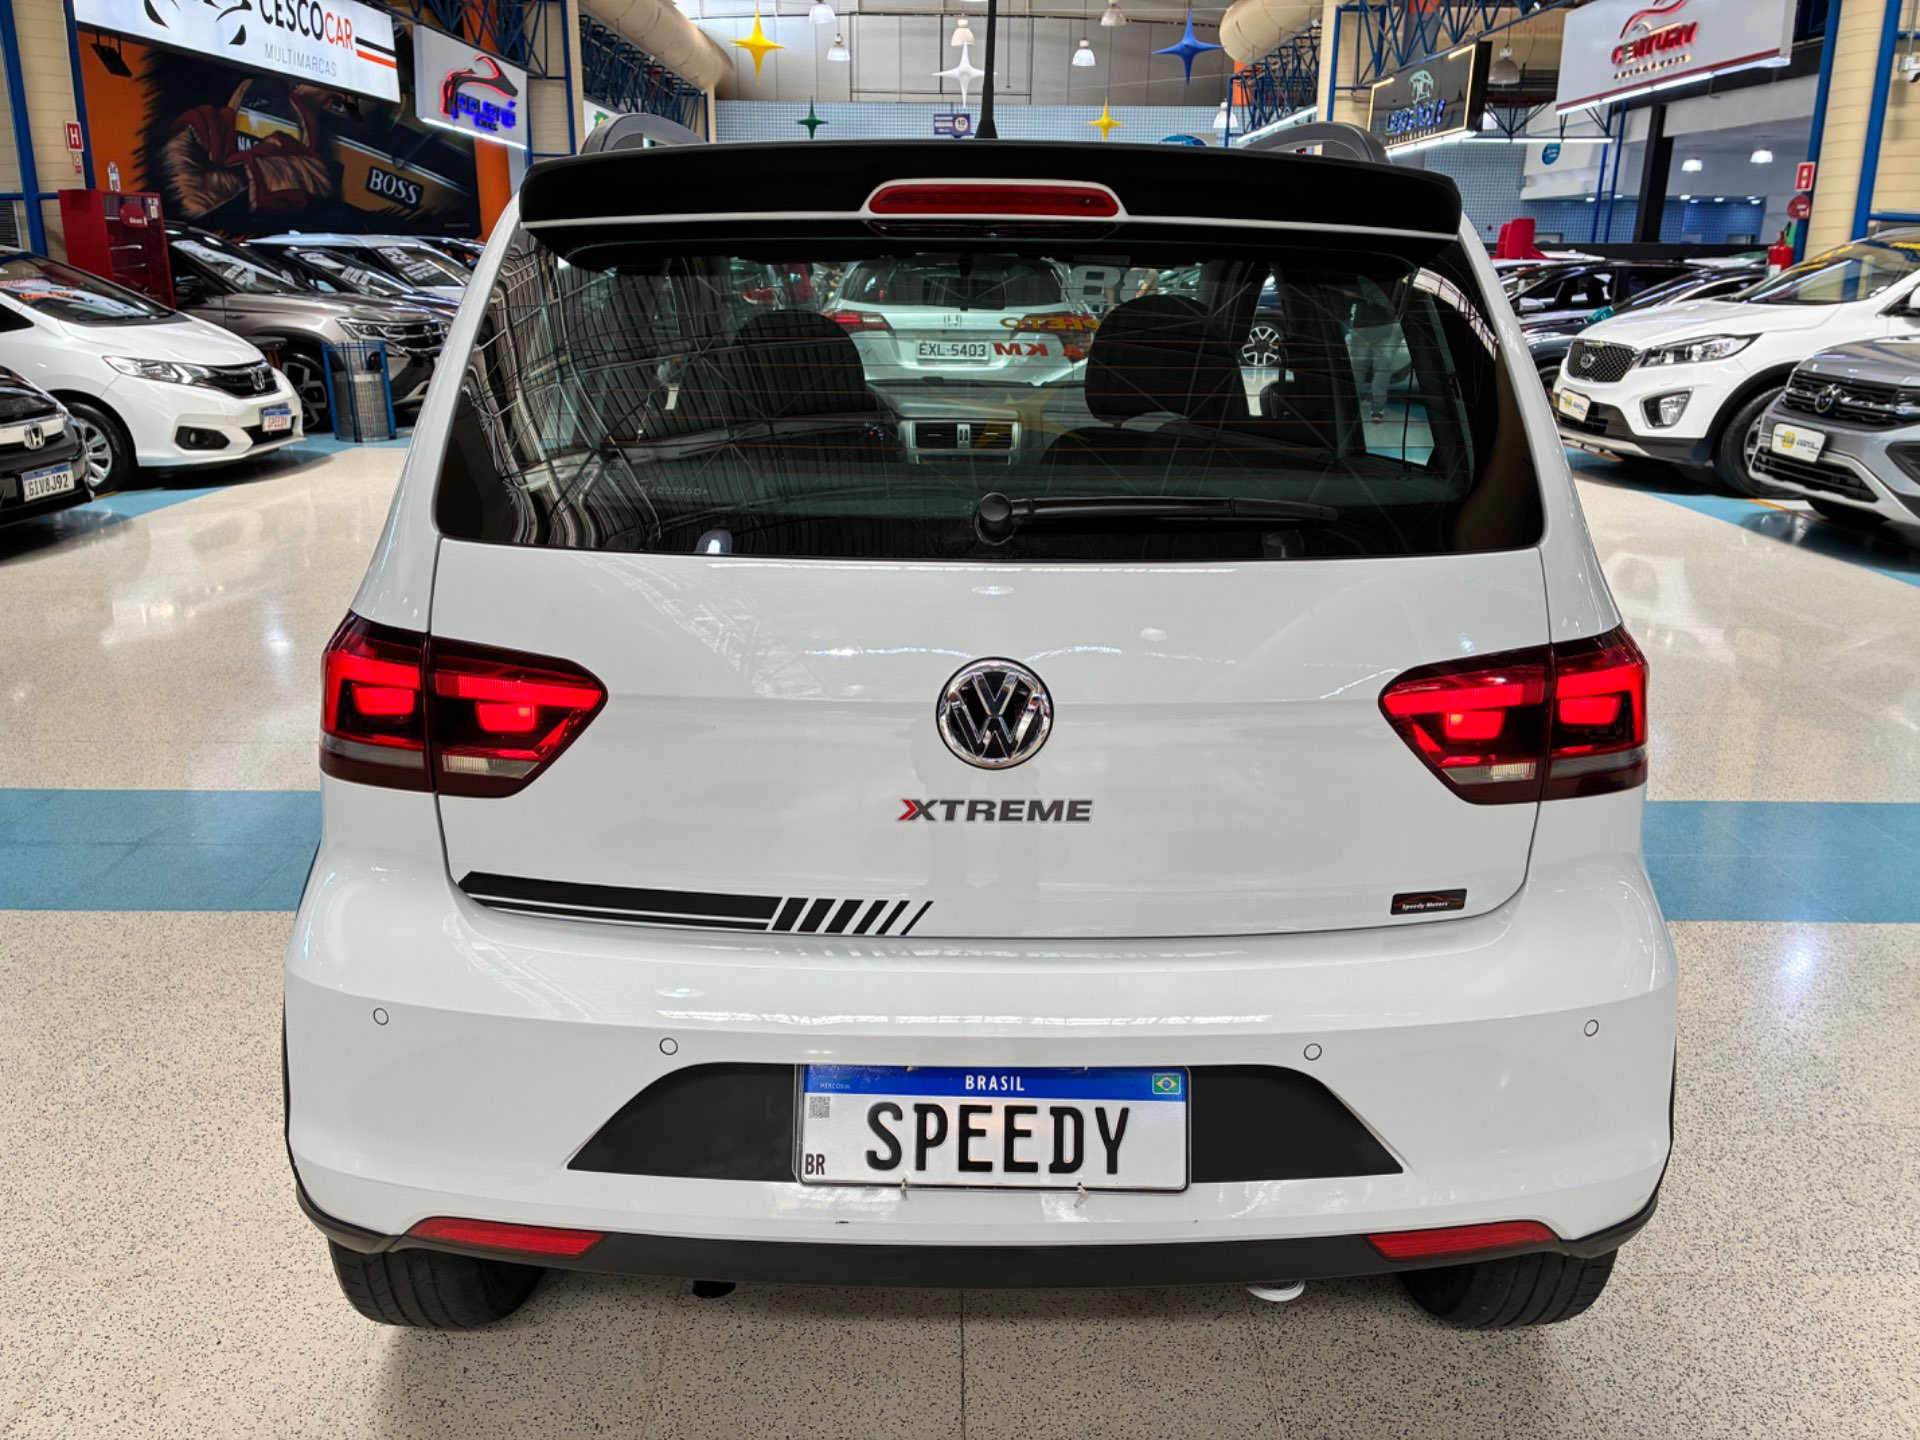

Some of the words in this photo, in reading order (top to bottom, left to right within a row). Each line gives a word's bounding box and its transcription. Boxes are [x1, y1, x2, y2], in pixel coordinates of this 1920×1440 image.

[1611, 21, 1698, 66] CENTURY
[264, 43, 338, 77] MULTIMARCAS
[69, 127, 80, 146] H
[369, 168, 420, 205] BOSS
[898, 799, 1092, 822] XTREME
[965, 1074, 1025, 1092] BRASIL
[866, 1102, 1130, 1175] SPEEDY
[805, 1154, 826, 1176] BR
